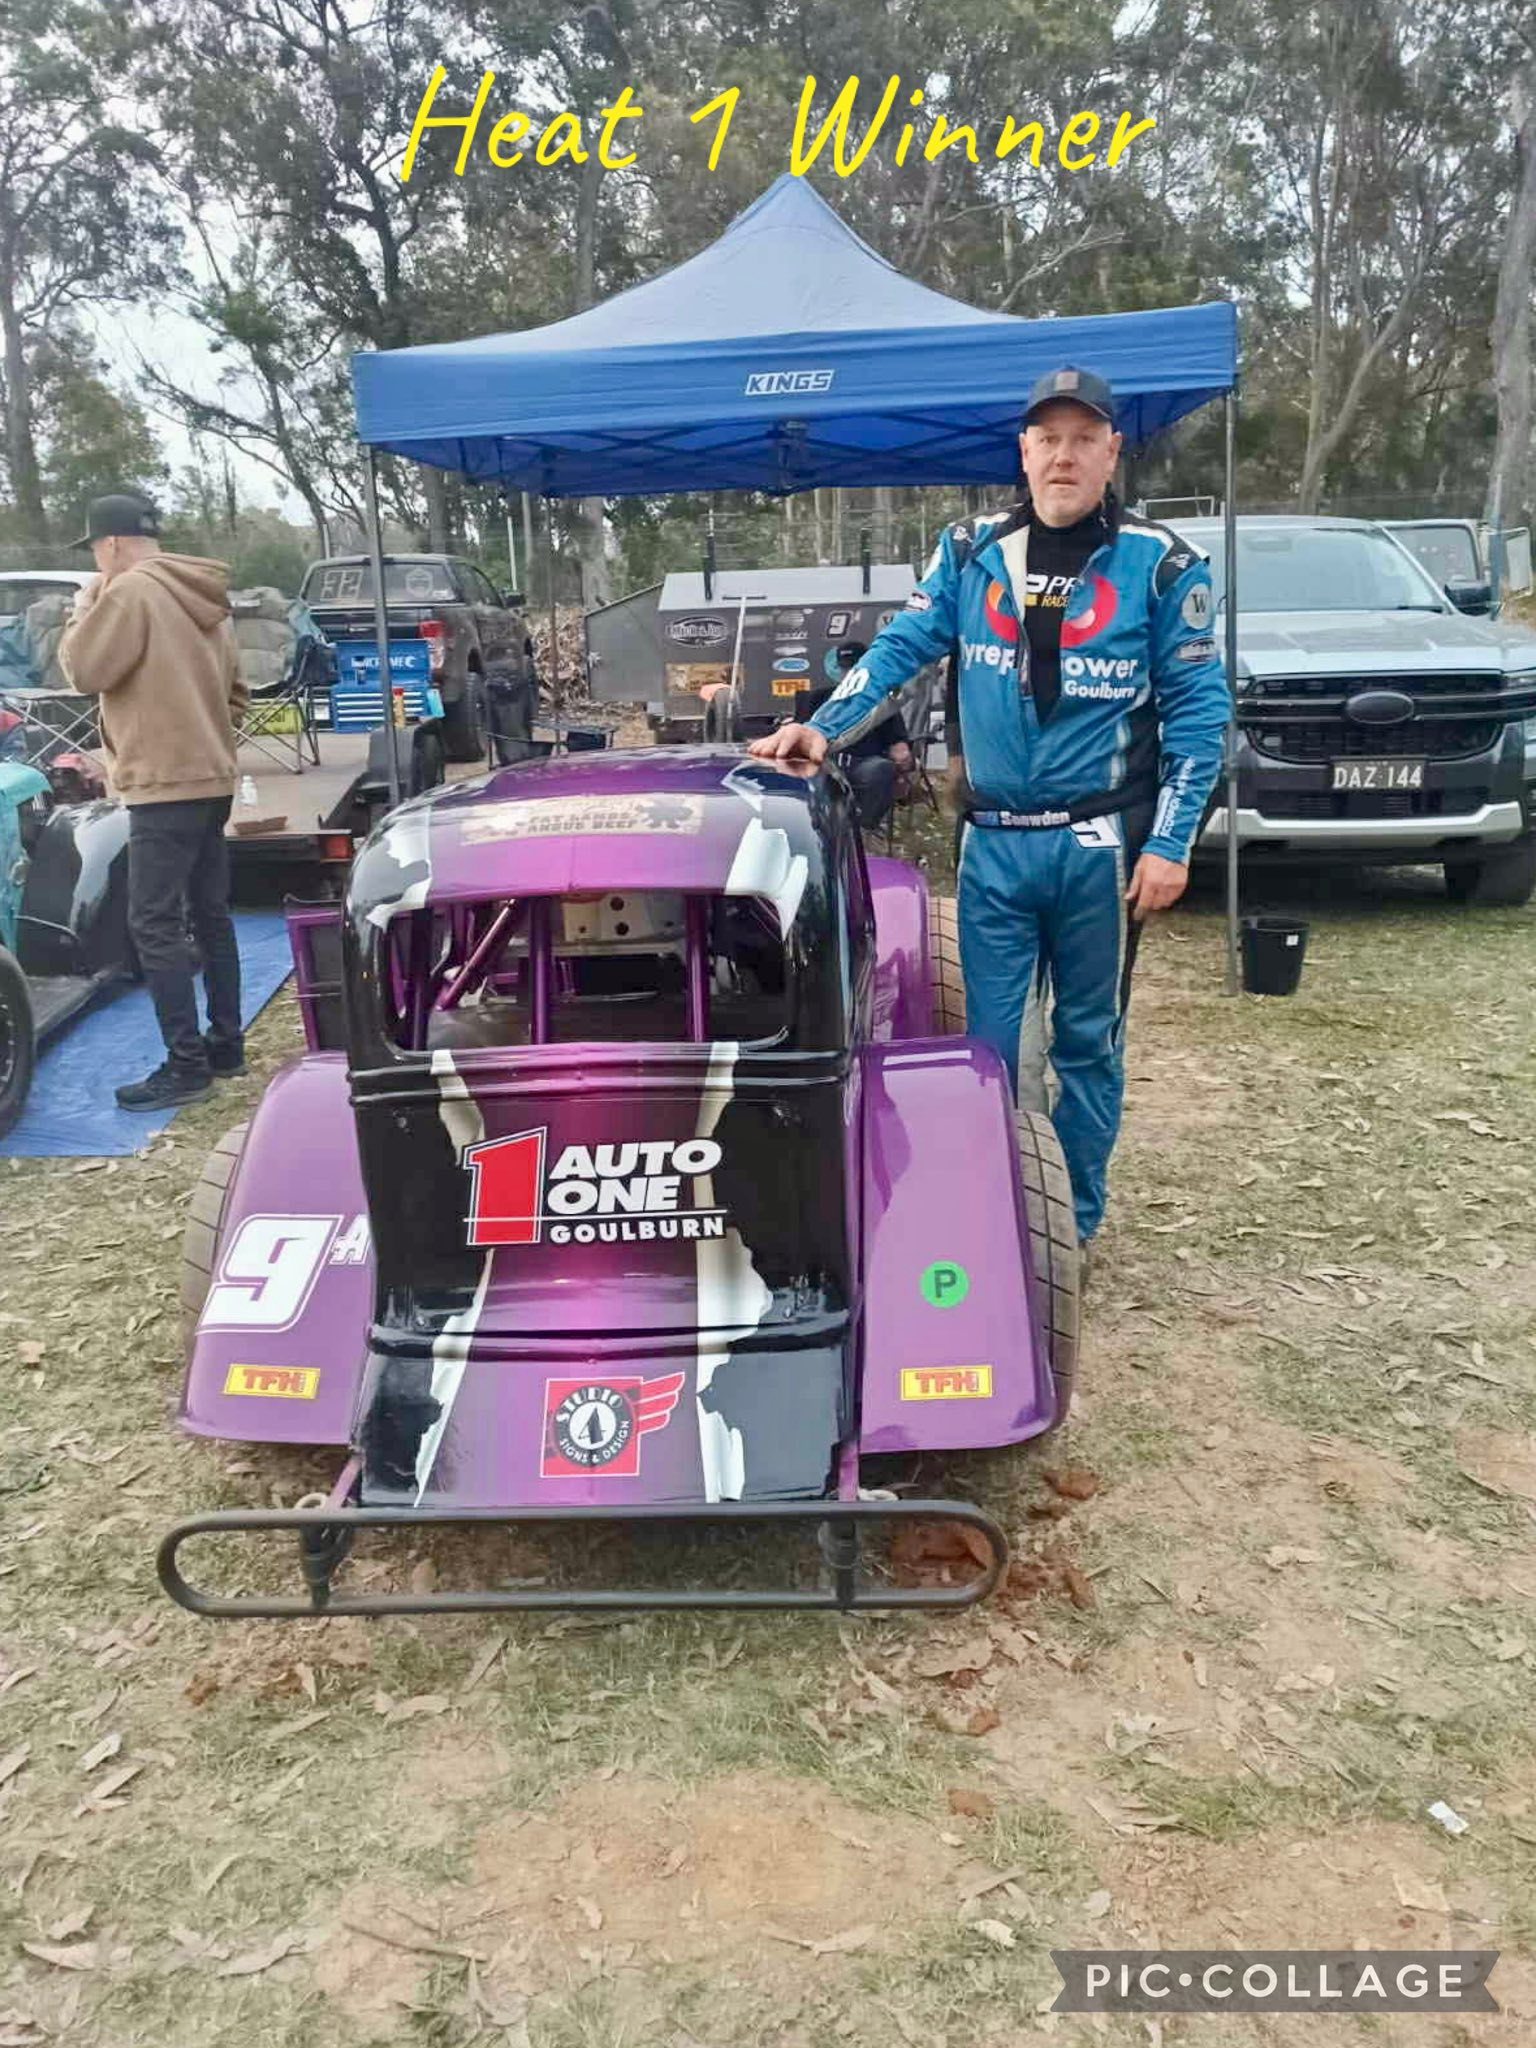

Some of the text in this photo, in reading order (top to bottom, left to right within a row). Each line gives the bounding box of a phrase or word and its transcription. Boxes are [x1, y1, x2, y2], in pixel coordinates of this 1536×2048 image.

[746, 370, 834, 395] KINGS
[1064, 680, 1136, 699] Goulburn
[1332, 765, 1422, 789] DAZ 144
[549, 1138, 722, 1180] AUTO
[463, 1127, 547, 1246] 1
[547, 1175, 681, 1215] ONE
[550, 1217, 725, 1244] GOULBURN
[195, 1213, 344, 1335] 9
[934, 1269, 958, 1299] P
[556, 1387, 623, 1422] STUDIO
[559, 1438, 588, 1463] SIGNS
[602, 1420, 631, 1460] DESIGN
